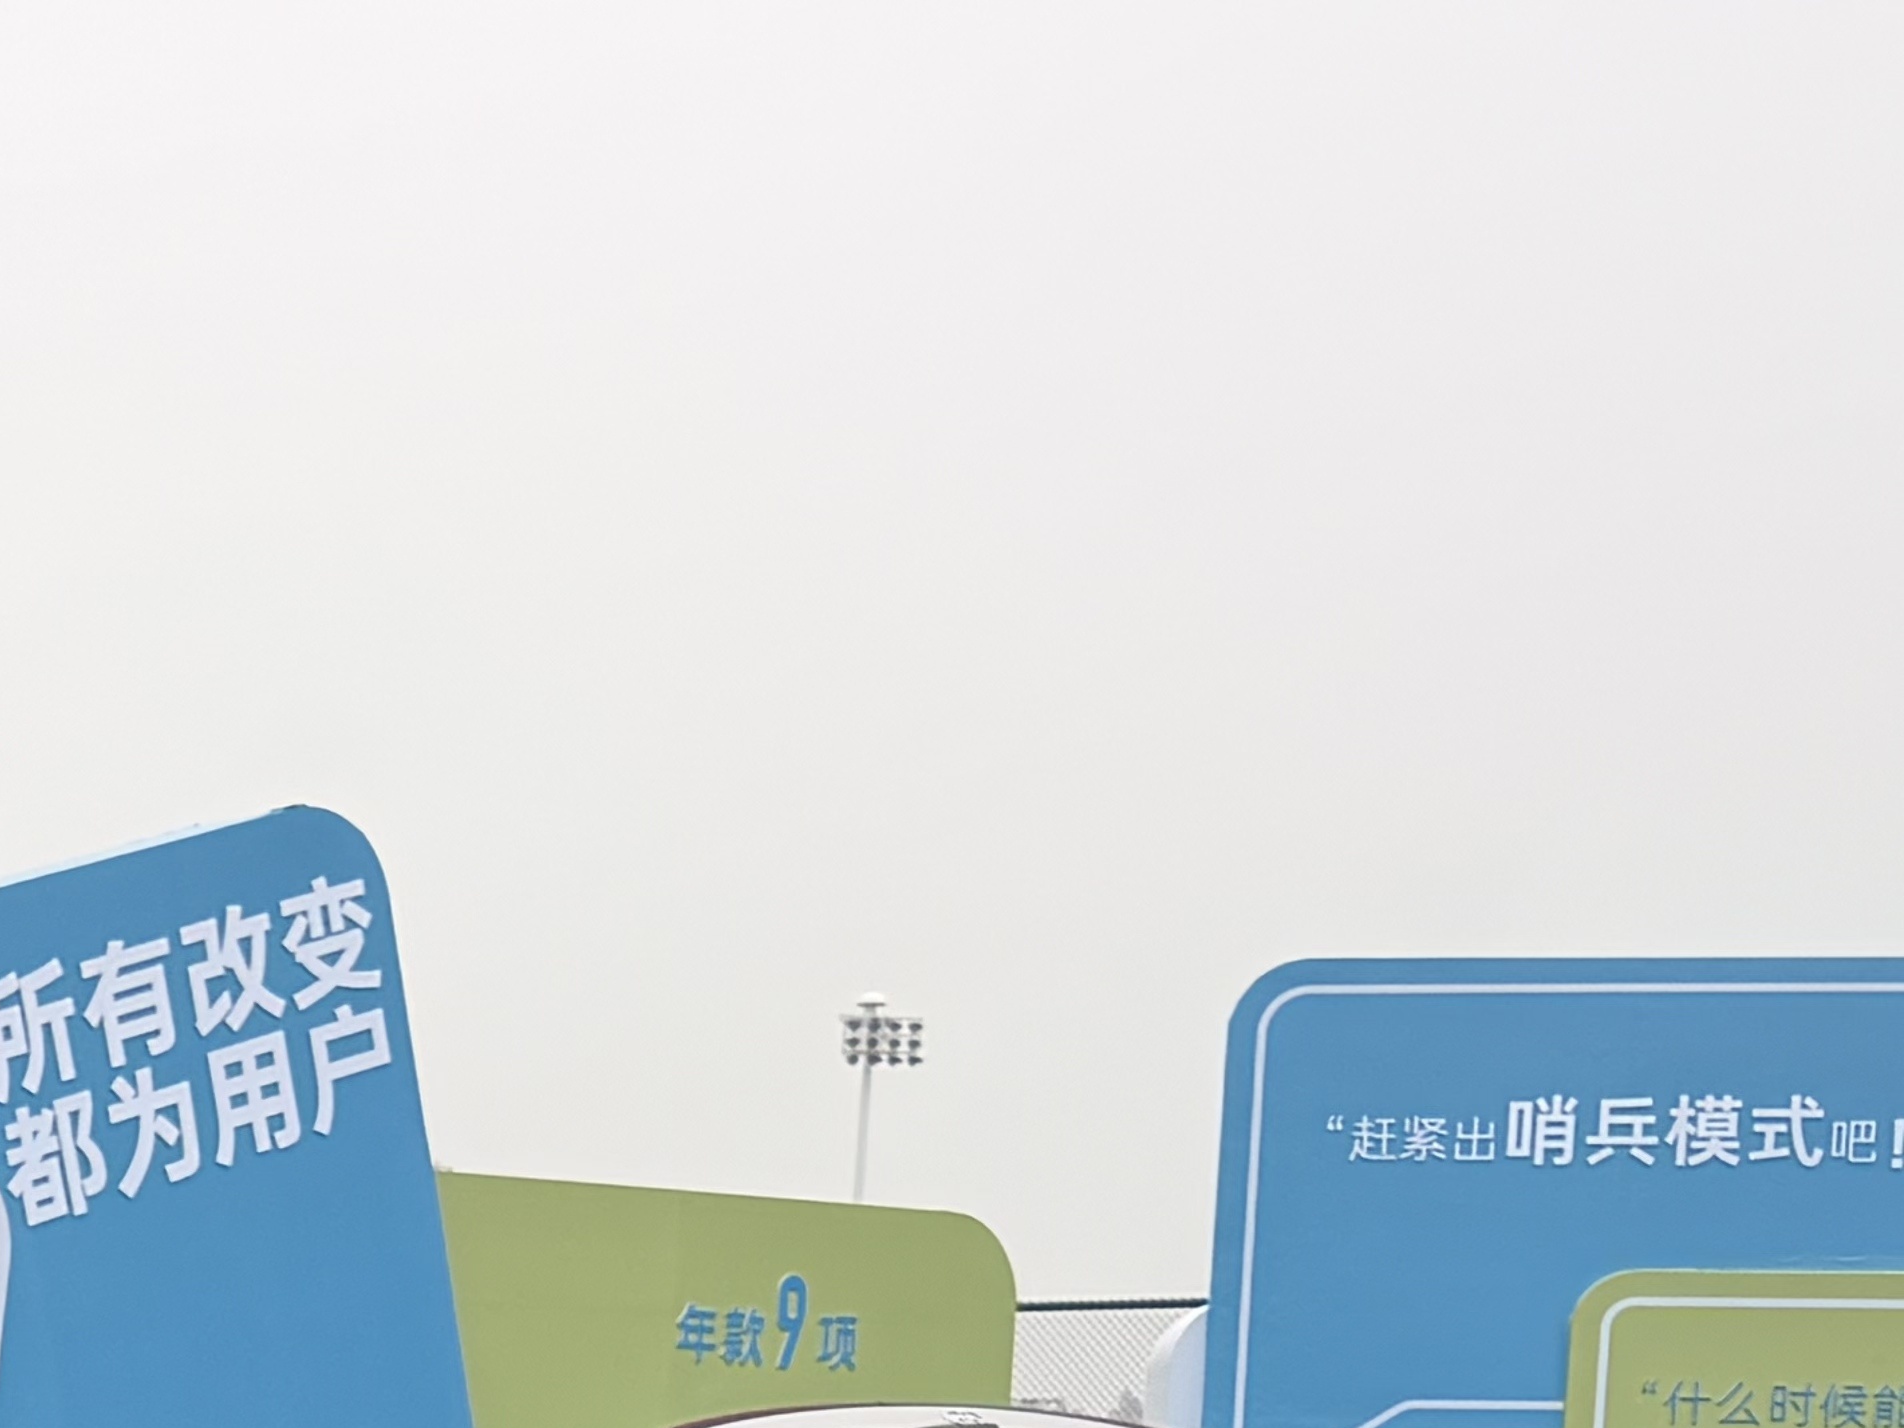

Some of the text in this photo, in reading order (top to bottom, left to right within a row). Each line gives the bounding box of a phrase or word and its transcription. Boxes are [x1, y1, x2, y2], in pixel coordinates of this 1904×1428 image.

[4, 1005, 392, 1229] 都为用户
[676, 1273, 858, 1371] 年款9项
